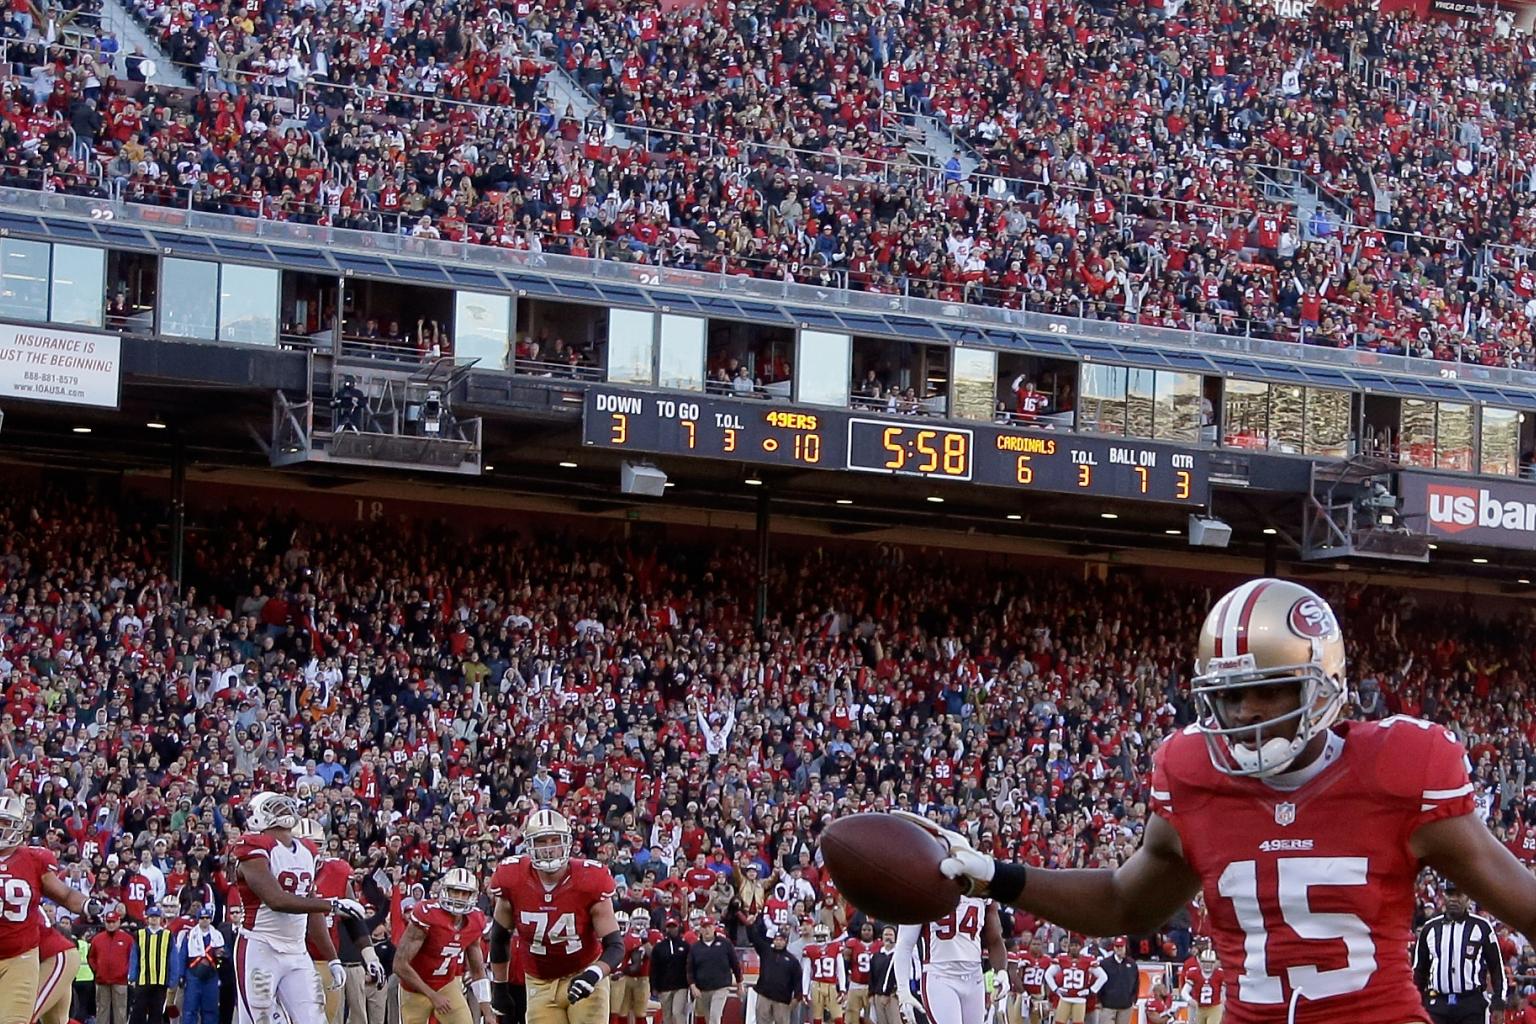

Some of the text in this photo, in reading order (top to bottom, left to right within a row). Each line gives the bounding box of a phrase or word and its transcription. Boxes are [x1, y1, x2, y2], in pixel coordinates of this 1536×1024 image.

[246, 0, 258, 11] 21
[889, 71, 899, 82] 21
[385, 194, 396, 205] 16
[569, 184, 581, 197] 21
[91, 209, 113, 220] 22
[1094, 202, 1106, 213] 15
[1264, 220, 1276, 232] 54
[1365, 237, 1375, 247] 16
[639, 274, 659, 285] 24
[14, 333, 96, 354] INSURANCE IS
[0, 349, 113, 373] UST THE BEGINNING
[24, 371, 79, 385] 888-881-8579
[14, 383, 85, 398] www.IOAUSA.com
[596, 394, 642, 415] DOWN
[656, 400, 699, 420] TO GO
[1023, 397, 1035, 412] 16
[611, 414, 626, 444] 3
[715, 413, 744, 430] T.O.L.
[766, 411, 817, 430] 49ERS
[681, 421, 695, 449] 7
[724, 429, 735, 452] 3
[794, 434, 820, 463] 10
[883, 427, 965, 475] 5:58
[996, 435, 1055, 455] CARDINALS
[1071, 449, 1098, 466] T.O.L.
[1109, 448, 1156, 467] BALL ON
[1172, 454, 1194, 469] QTR
[1017, 455, 1033, 484] 6
[1079, 465, 1090, 487] 3
[1135, 467, 1147, 494] 7
[1176, 471, 1190, 499] 3
[354, 500, 382, 521] 18
[604, 698, 615, 710] 21
[393, 749, 407, 764] 85
[935, 765, 949, 778] 52
[1259, 839, 1314, 851] 49ERS
[1523, 837, 1536, 849] 52
[0, 879, 33, 922] 9
[128, 882, 145, 901] 16
[520, 911, 583, 956] 74
[1217, 857, 1378, 1004] 15
[433, 946, 463, 976] 7
[814, 957, 835, 978] 19
[858, 952, 871, 973] 9
[1023, 967, 1044, 986] 28
[1063, 969, 1084, 989] 29
[1200, 986, 1213, 1004] 2
